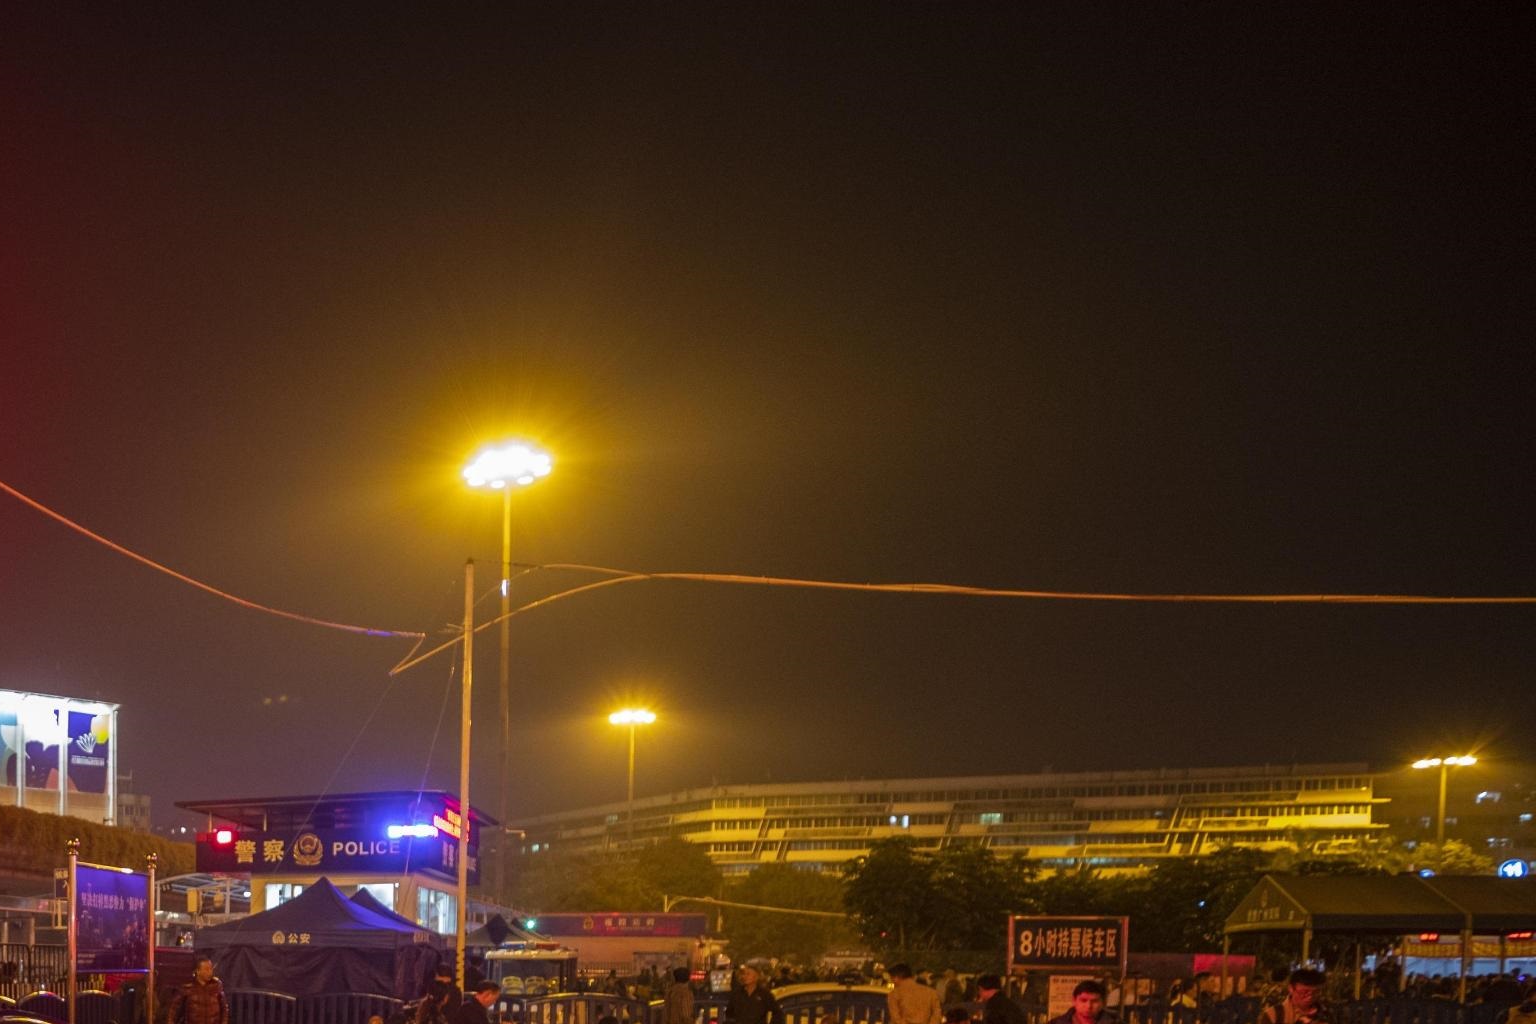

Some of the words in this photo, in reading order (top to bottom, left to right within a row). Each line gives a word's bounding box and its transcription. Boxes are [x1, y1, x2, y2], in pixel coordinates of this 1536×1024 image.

[235, 838, 285, 864] 警察
[332, 840, 401, 857] POLICE
[288, 933, 311, 945] 公安
[1019, 927, 1117, 958] 8小时持票候车区
